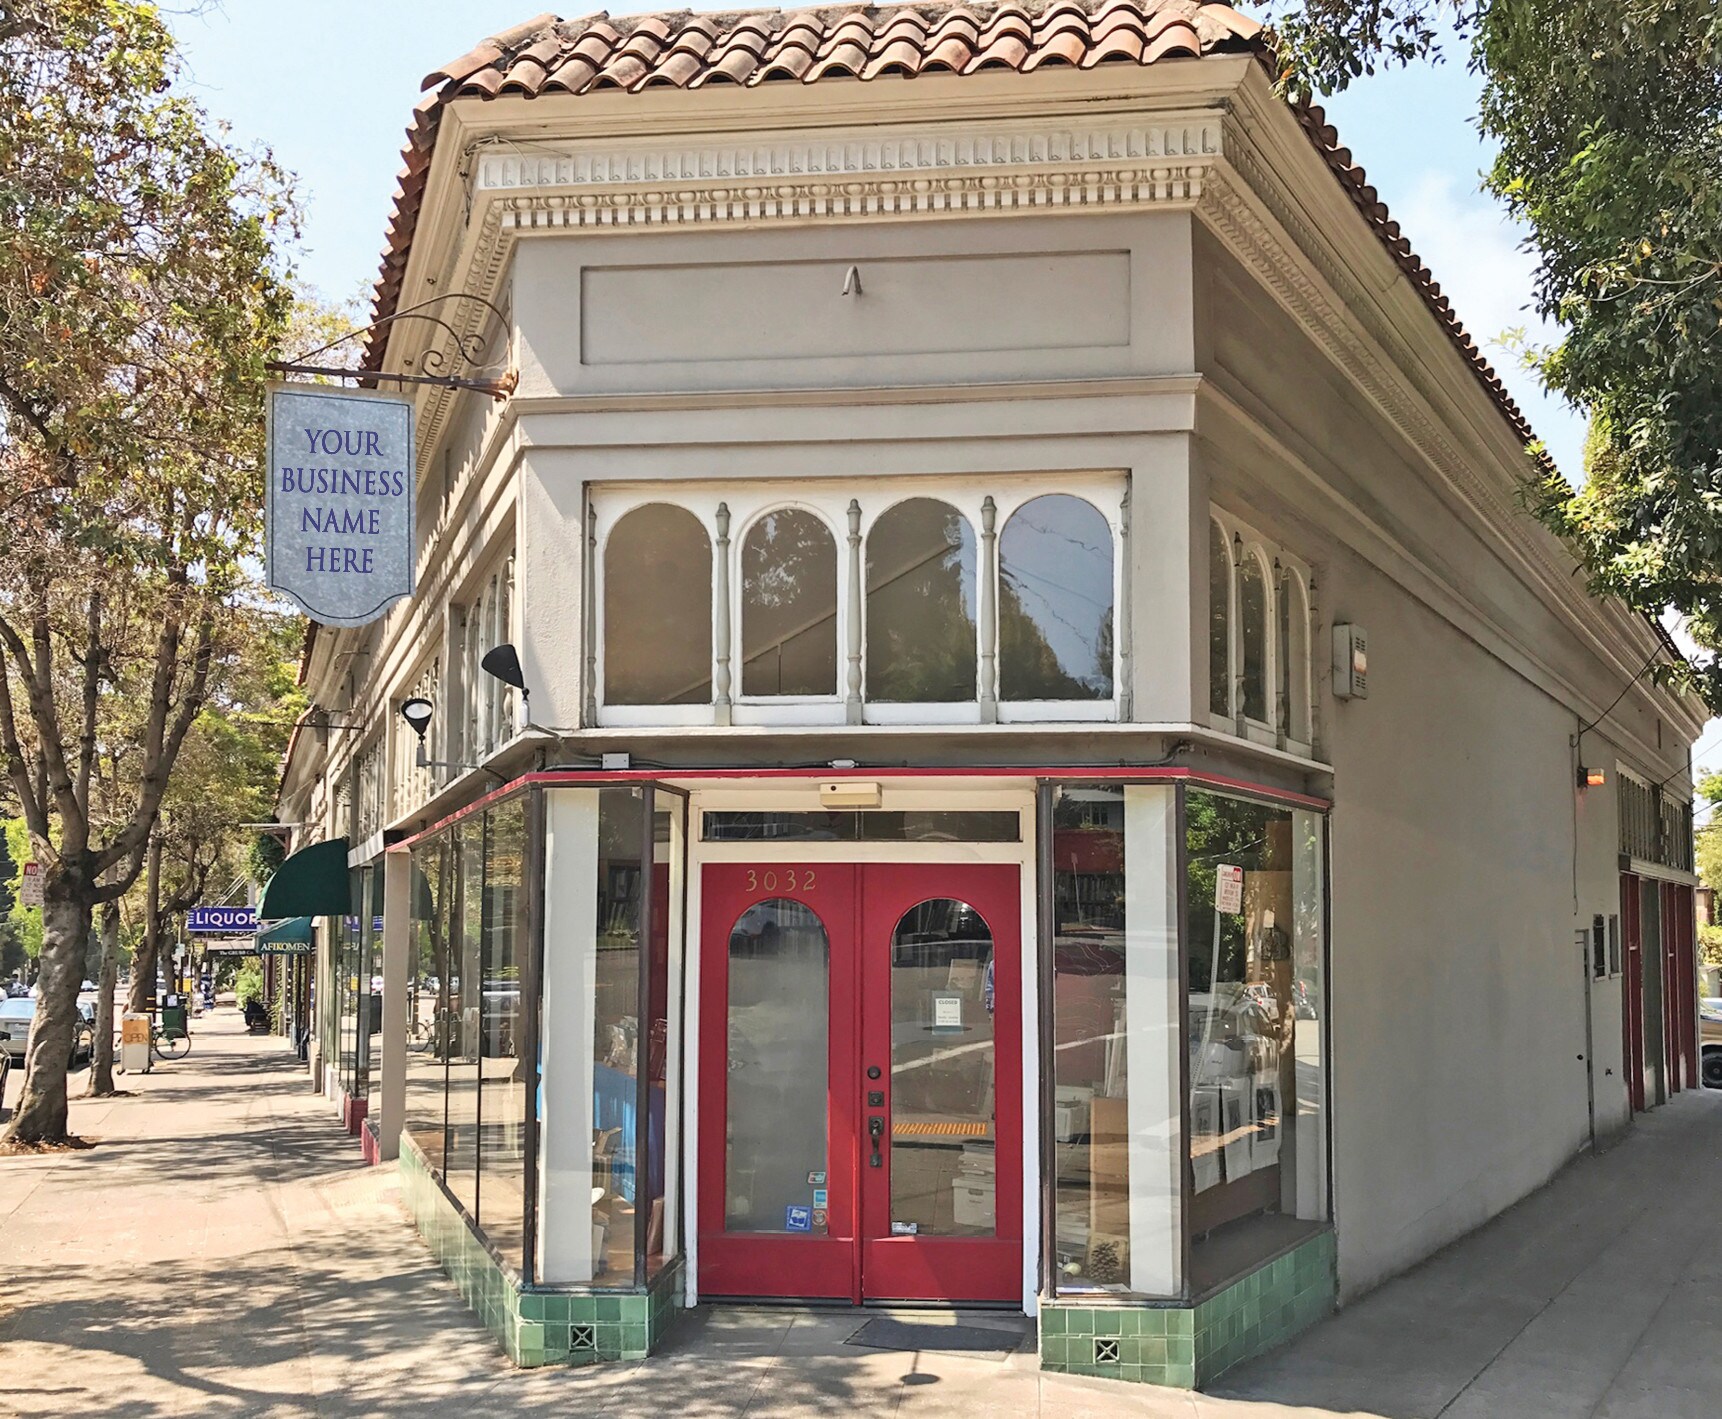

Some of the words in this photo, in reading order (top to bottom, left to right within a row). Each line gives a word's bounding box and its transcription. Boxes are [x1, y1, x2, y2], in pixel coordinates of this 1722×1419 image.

[304, 429, 384, 456] YOUR
[281, 467, 404, 497] BUSINESS
[301, 507, 380, 535] NAME
[305, 546, 374, 574] HERE
[26, 865, 38, 875] NO
[745, 869, 816, 892] 3032
[196, 912, 258, 927] LIQUOR
[260, 942, 311, 952] AFIKOMEN
[124, 1033, 148, 1043] OPEN
